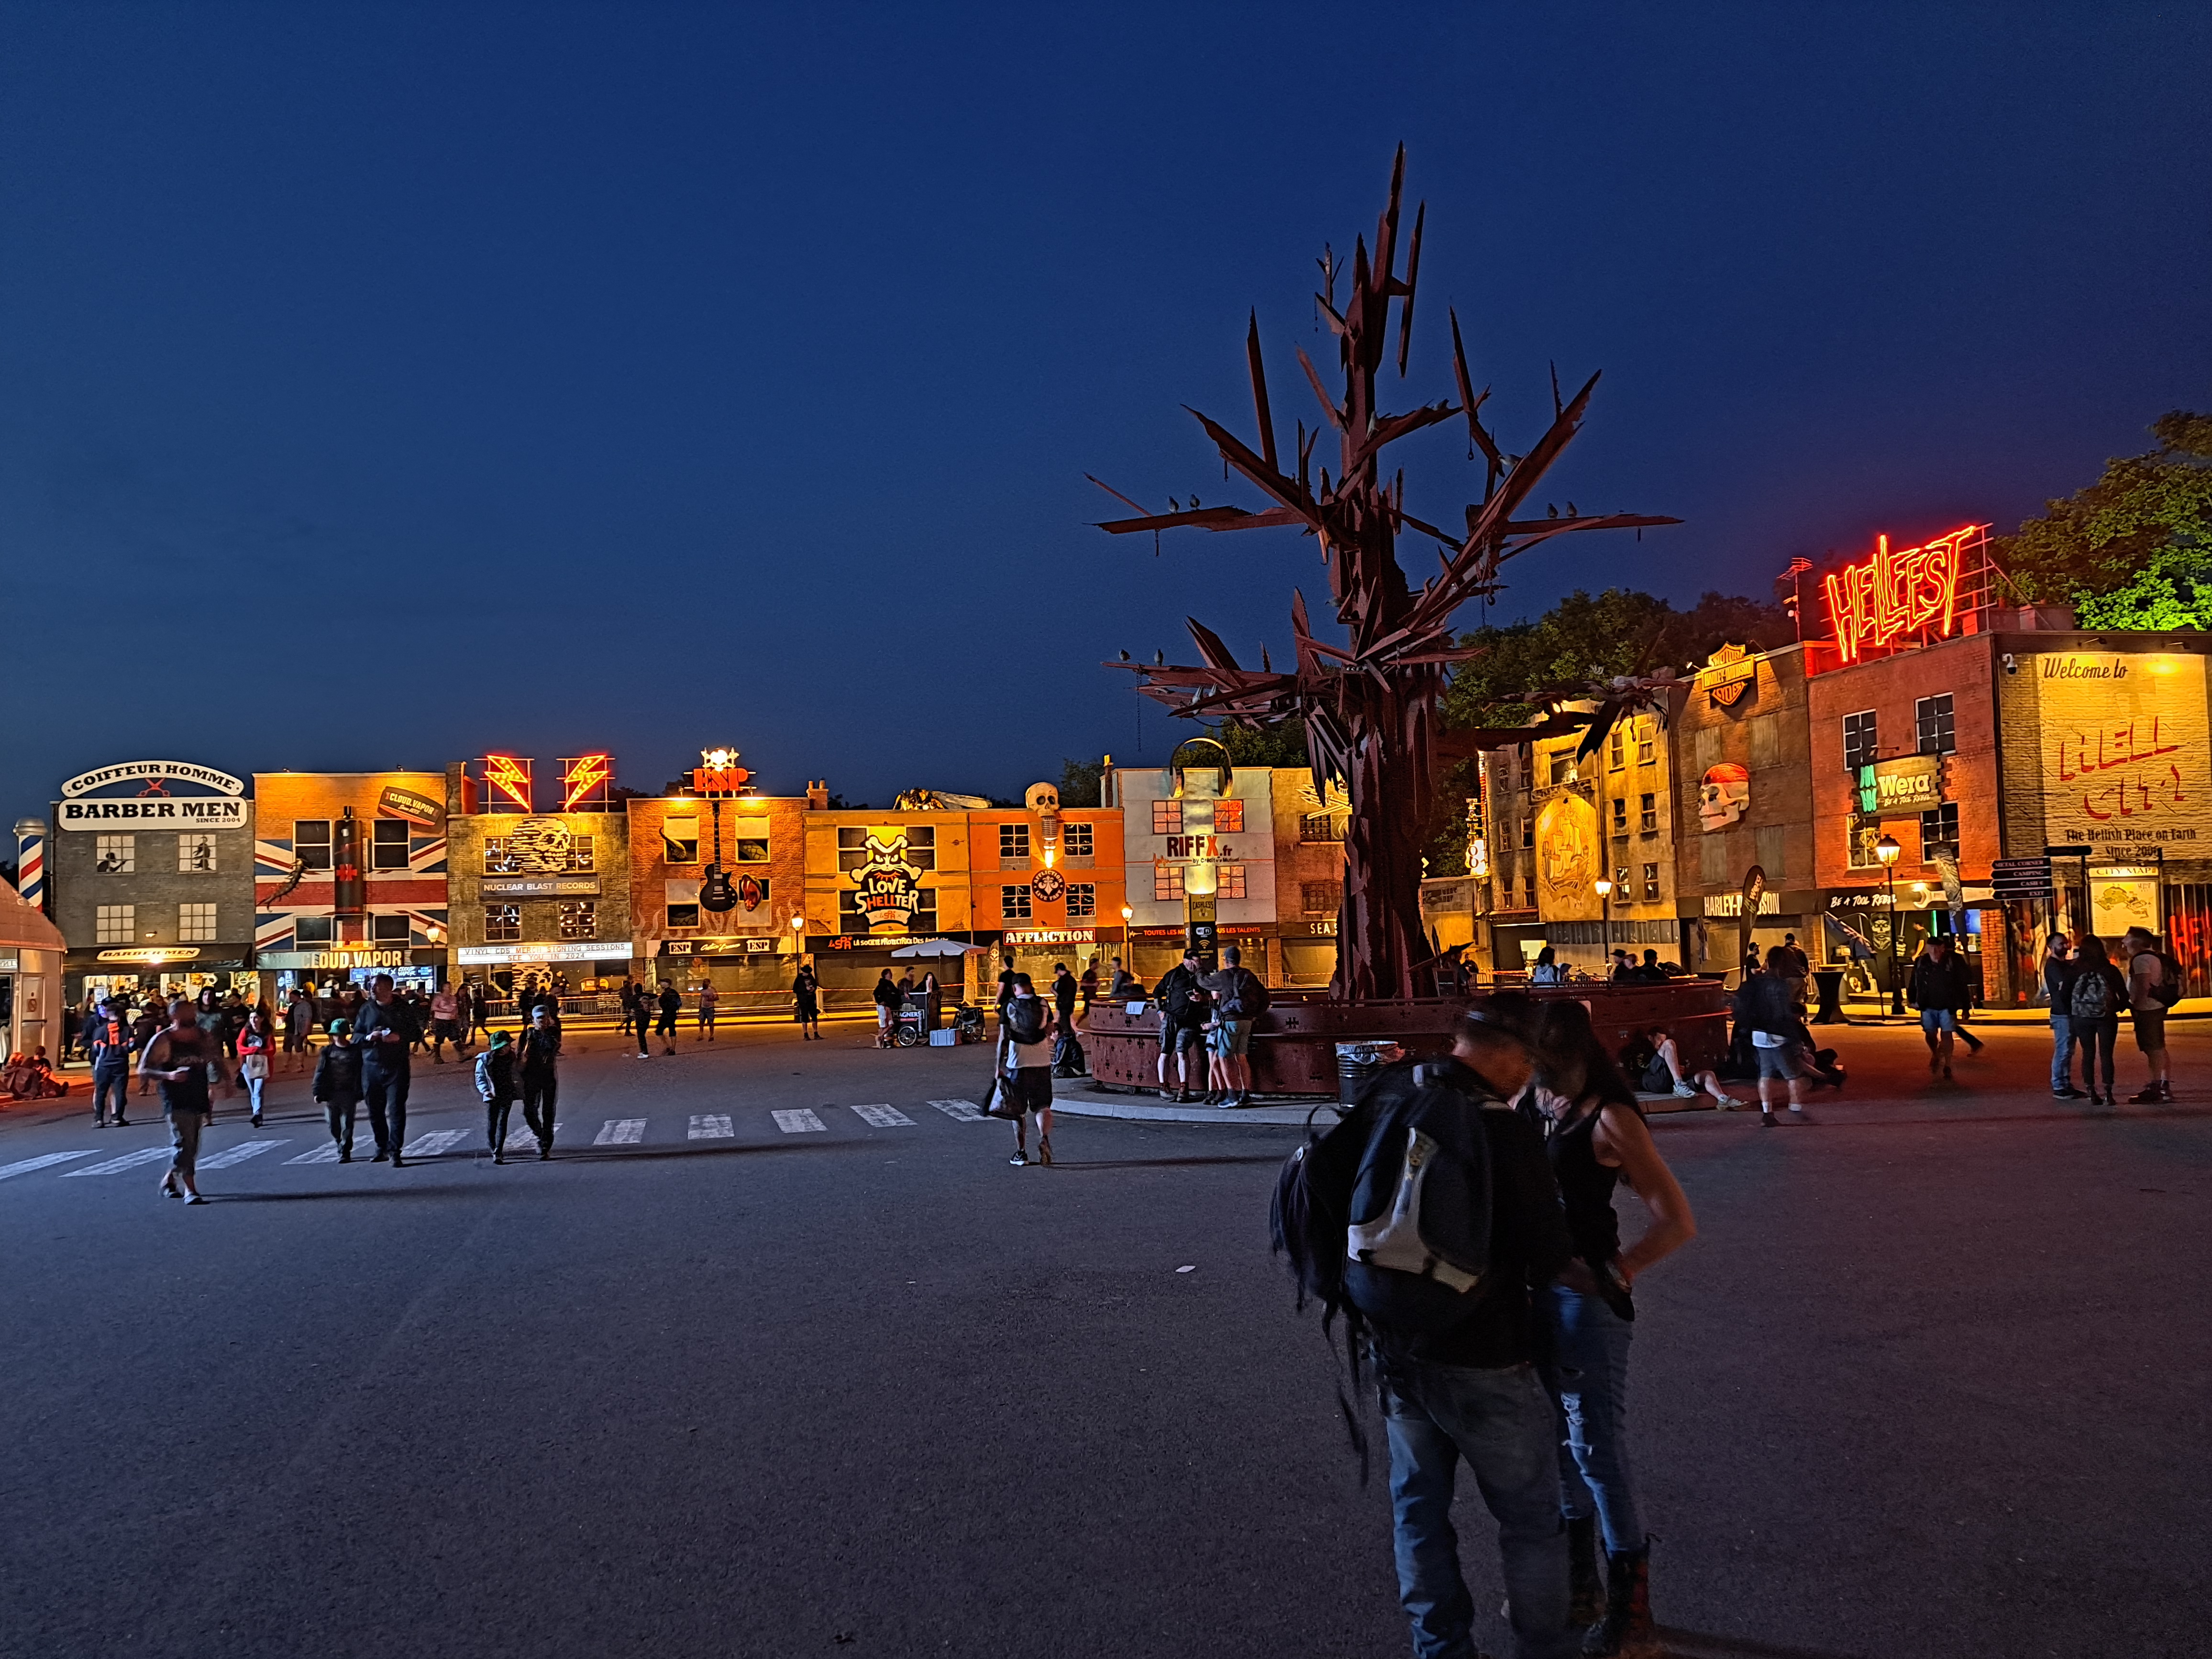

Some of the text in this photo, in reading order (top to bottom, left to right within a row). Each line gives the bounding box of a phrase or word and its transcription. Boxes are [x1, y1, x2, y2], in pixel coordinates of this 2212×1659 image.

[1827, 526, 1976, 662] HELLFEST
[1713, 651, 1744, 666] MOTOR
[1704, 660, 1752, 687] HARLEY-DAVIDSON
[2044, 657, 2129, 679] Welcome to
[1716, 683, 1742, 702] CYCLES
[2059, 716, 2186, 781] HELL
[71, 764, 235, 790] COIFFEUR HOMME
[694, 768, 748, 792] ESP
[1878, 774, 1930, 797] Wera
[66, 802, 240, 818] BARBER MEN
[389, 793, 435, 815] CLOUD.VAPOR
[1465, 798, 1479, 868] TATTOO
[2065, 828, 2197, 841] The Hellish Place on Earth
[2105, 845, 2131, 858] Since
[1034, 871, 1063, 884] AFFLICTION
[484, 883, 523, 891] NUCLEAR
[868, 878, 907, 894] LOVE
[855, 890, 919, 915] SHELLTER
[1035, 889, 1062, 901] LIVE FAST
[1830, 896, 1843, 907] BE
[1844, 897, 1850, 906] A
[1852, 895, 1870, 907] TOOL
[1193, 901, 1214, 909] CASHLESS
[1704, 892, 1780, 917] HARLEY-DSON
[1006, 930, 1093, 943] AFFLICTION
[1311, 923, 1330, 934] SEA
[671, 944, 691, 952] ESP
[749, 941, 770, 950] ESP
[835, 936, 852, 950] SPA
[302, 951, 402, 968] CLOUD.VAPOR
